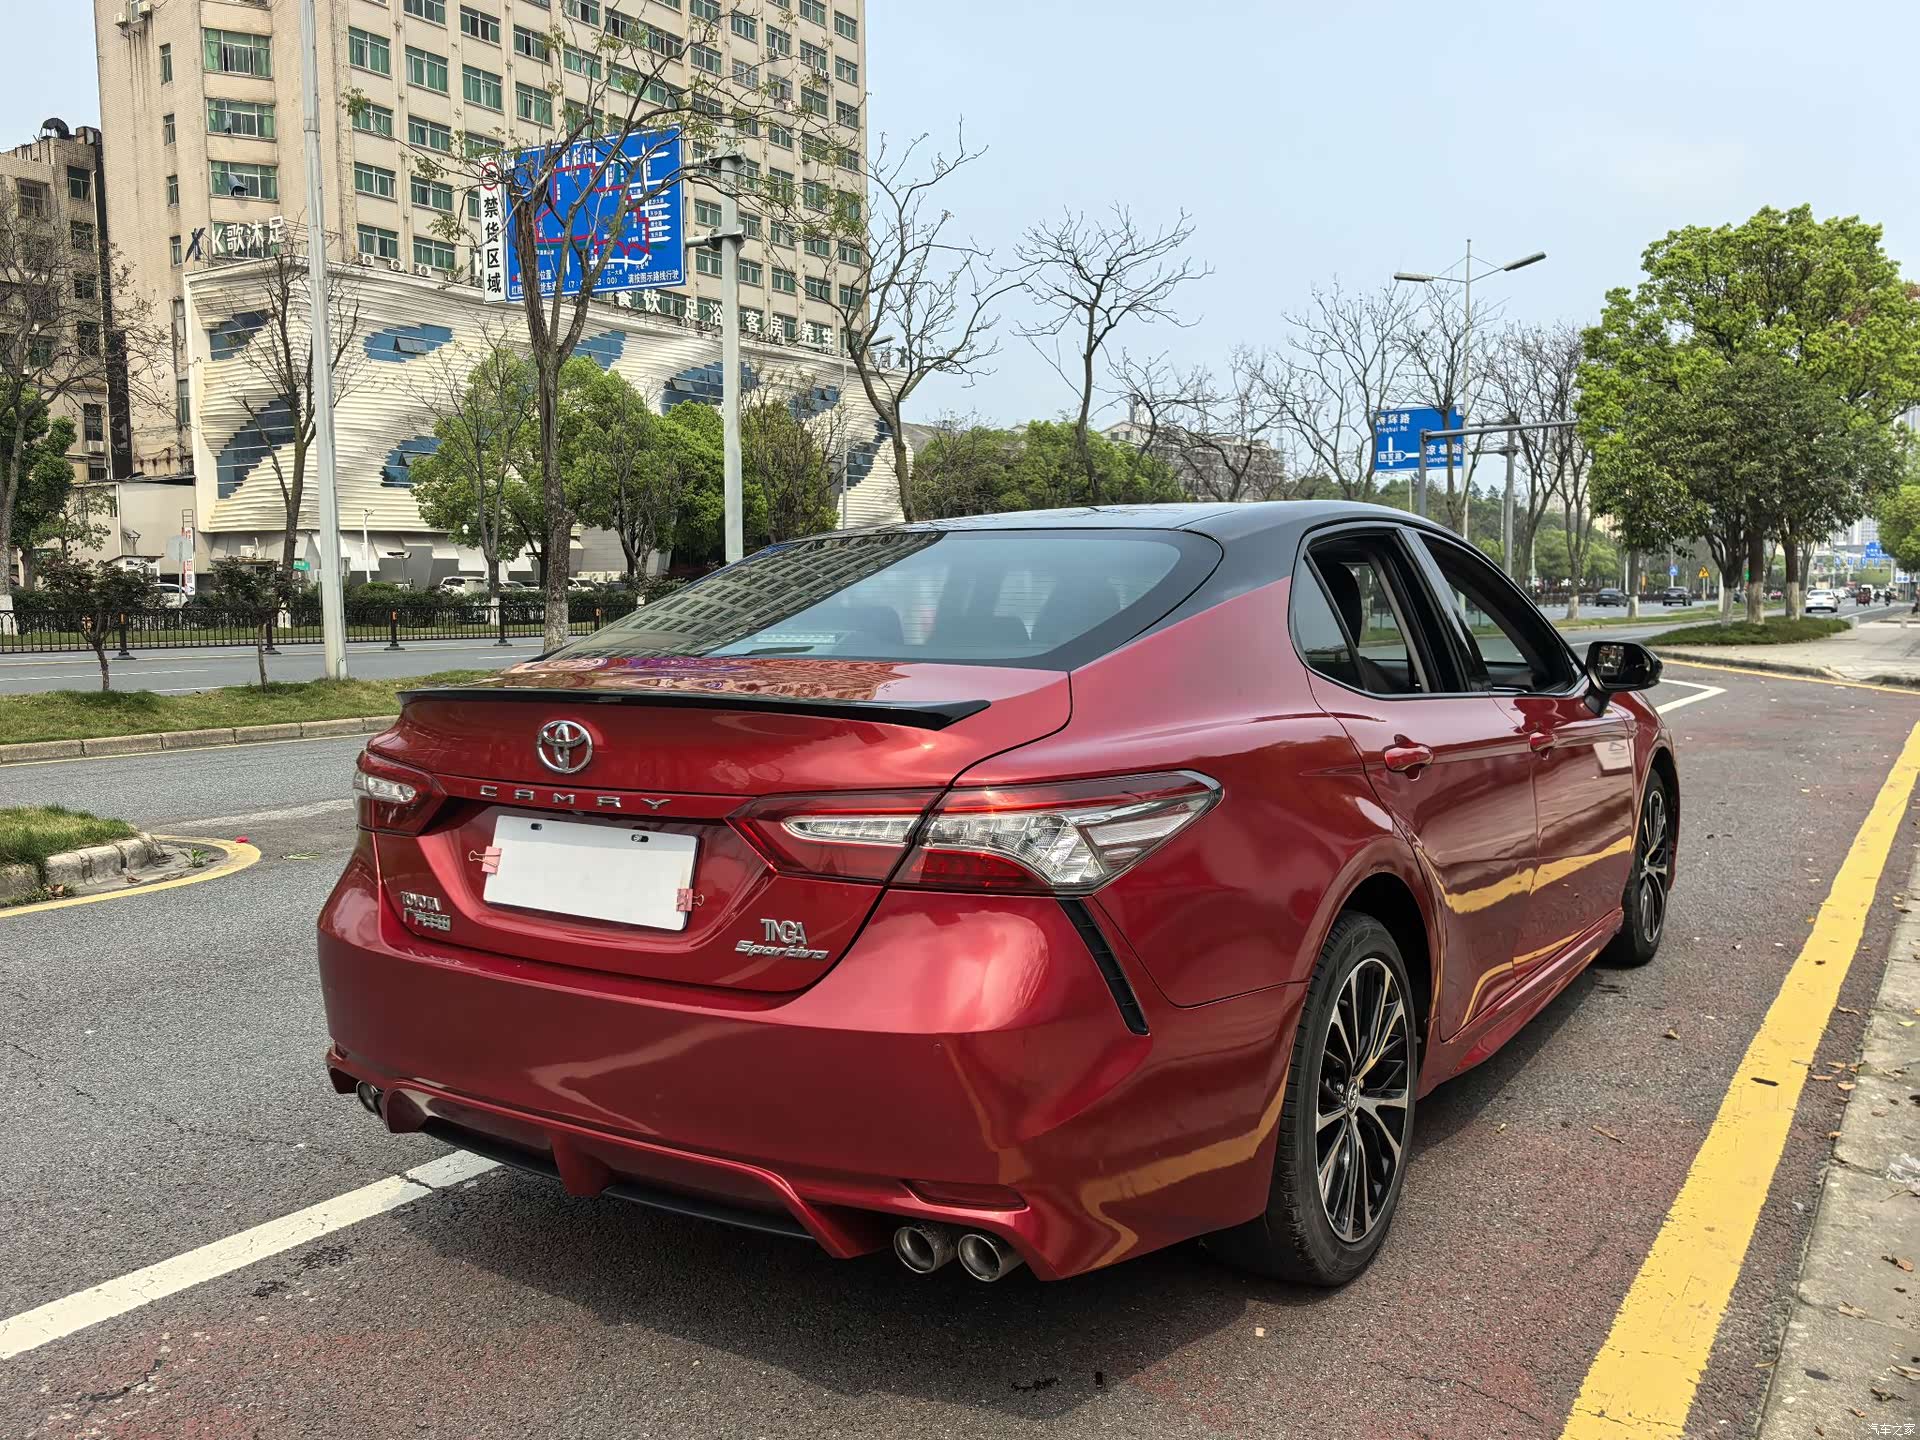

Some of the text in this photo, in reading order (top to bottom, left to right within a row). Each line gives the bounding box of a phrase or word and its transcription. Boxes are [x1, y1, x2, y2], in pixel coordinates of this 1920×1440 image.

[211, 215, 286, 255] K歌沐足
[484, 196, 502, 293] 禁货区域
[746, 310, 783, 338] 客房
[480, 784, 671, 811] CAMRY
[400, 890, 442, 912] TOYOTA
[760, 918, 808, 945] TNGA
[734, 939, 830, 960] Sportivo
